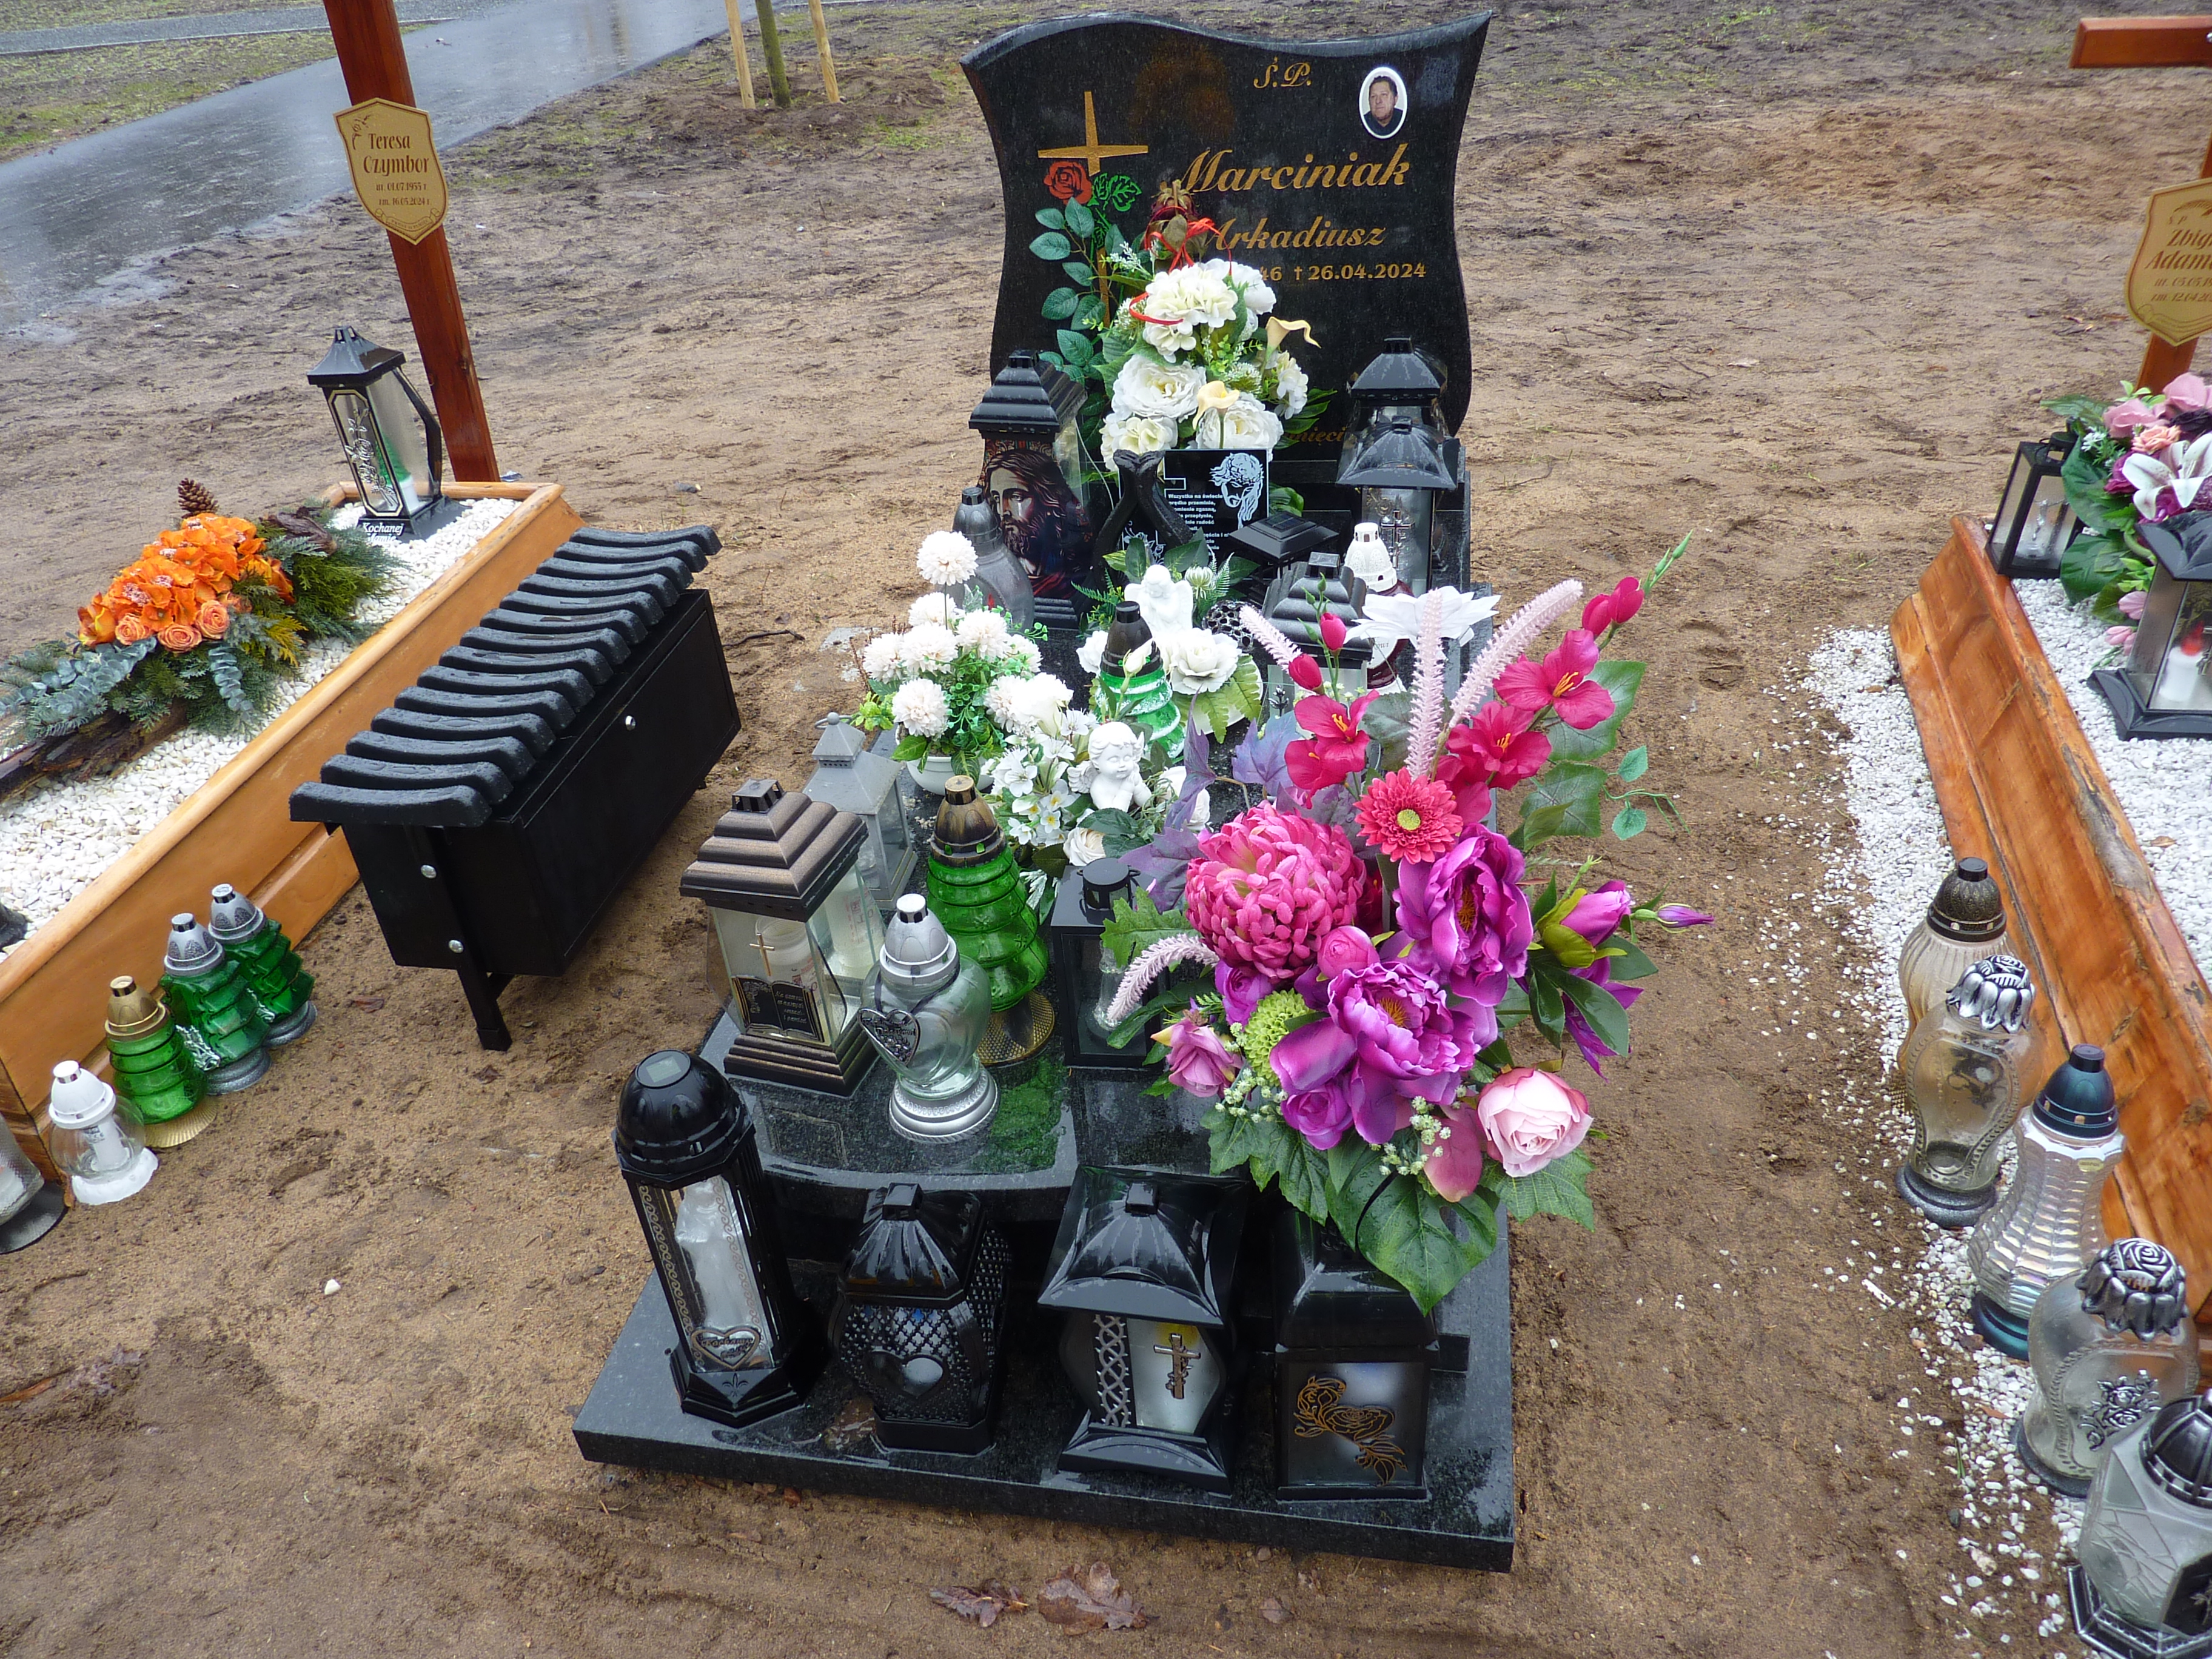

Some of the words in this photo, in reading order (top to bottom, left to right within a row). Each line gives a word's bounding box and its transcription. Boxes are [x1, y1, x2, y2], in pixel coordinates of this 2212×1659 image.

[368, 133, 411, 150] Teresa
[363, 155, 429, 176] Czymbor
[1180, 142, 1410, 193] Marciniak
[1205, 216, 1386, 250] Arkadiusz
[1308, 263, 1426, 280] 26.04.2024
[363, 522, 404, 536] Kochanej
